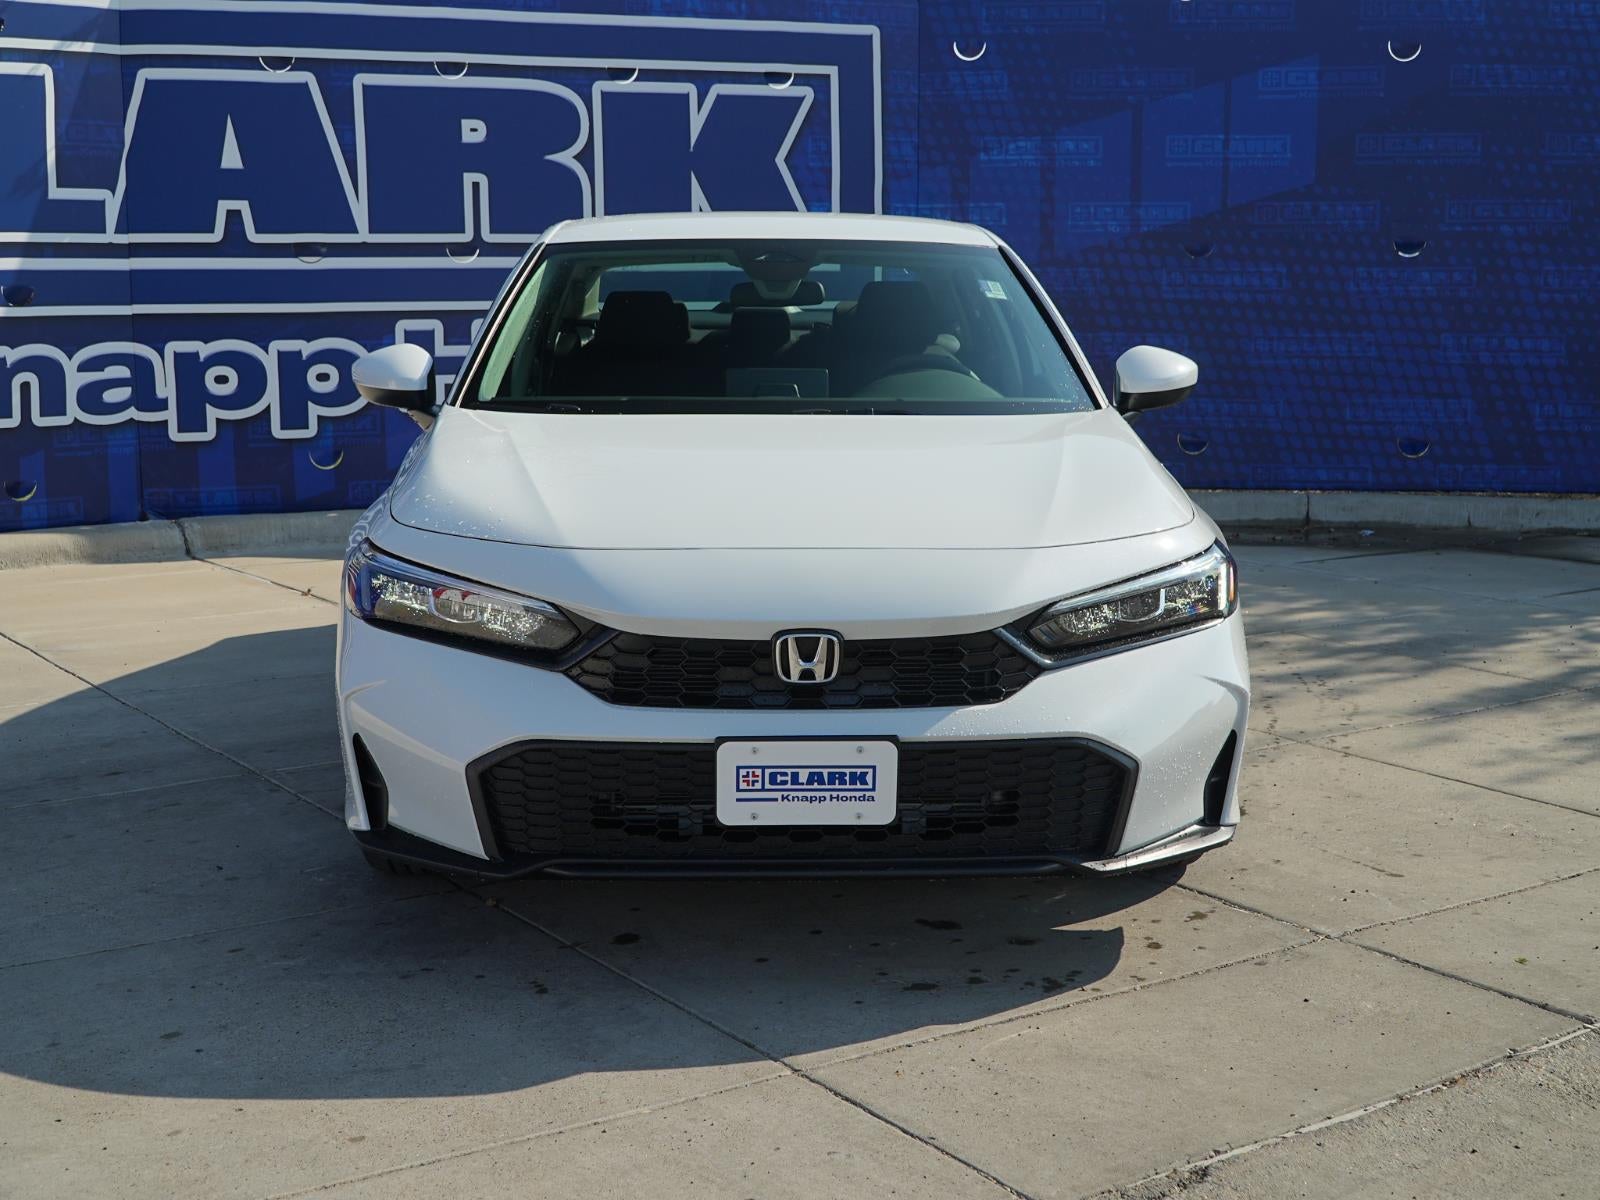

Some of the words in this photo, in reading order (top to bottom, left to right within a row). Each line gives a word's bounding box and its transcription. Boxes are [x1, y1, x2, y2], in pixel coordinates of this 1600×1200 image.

[768, 771, 869, 786] CLARK
[780, 793, 827, 804] Knapp
[829, 793, 876, 802] Honda
